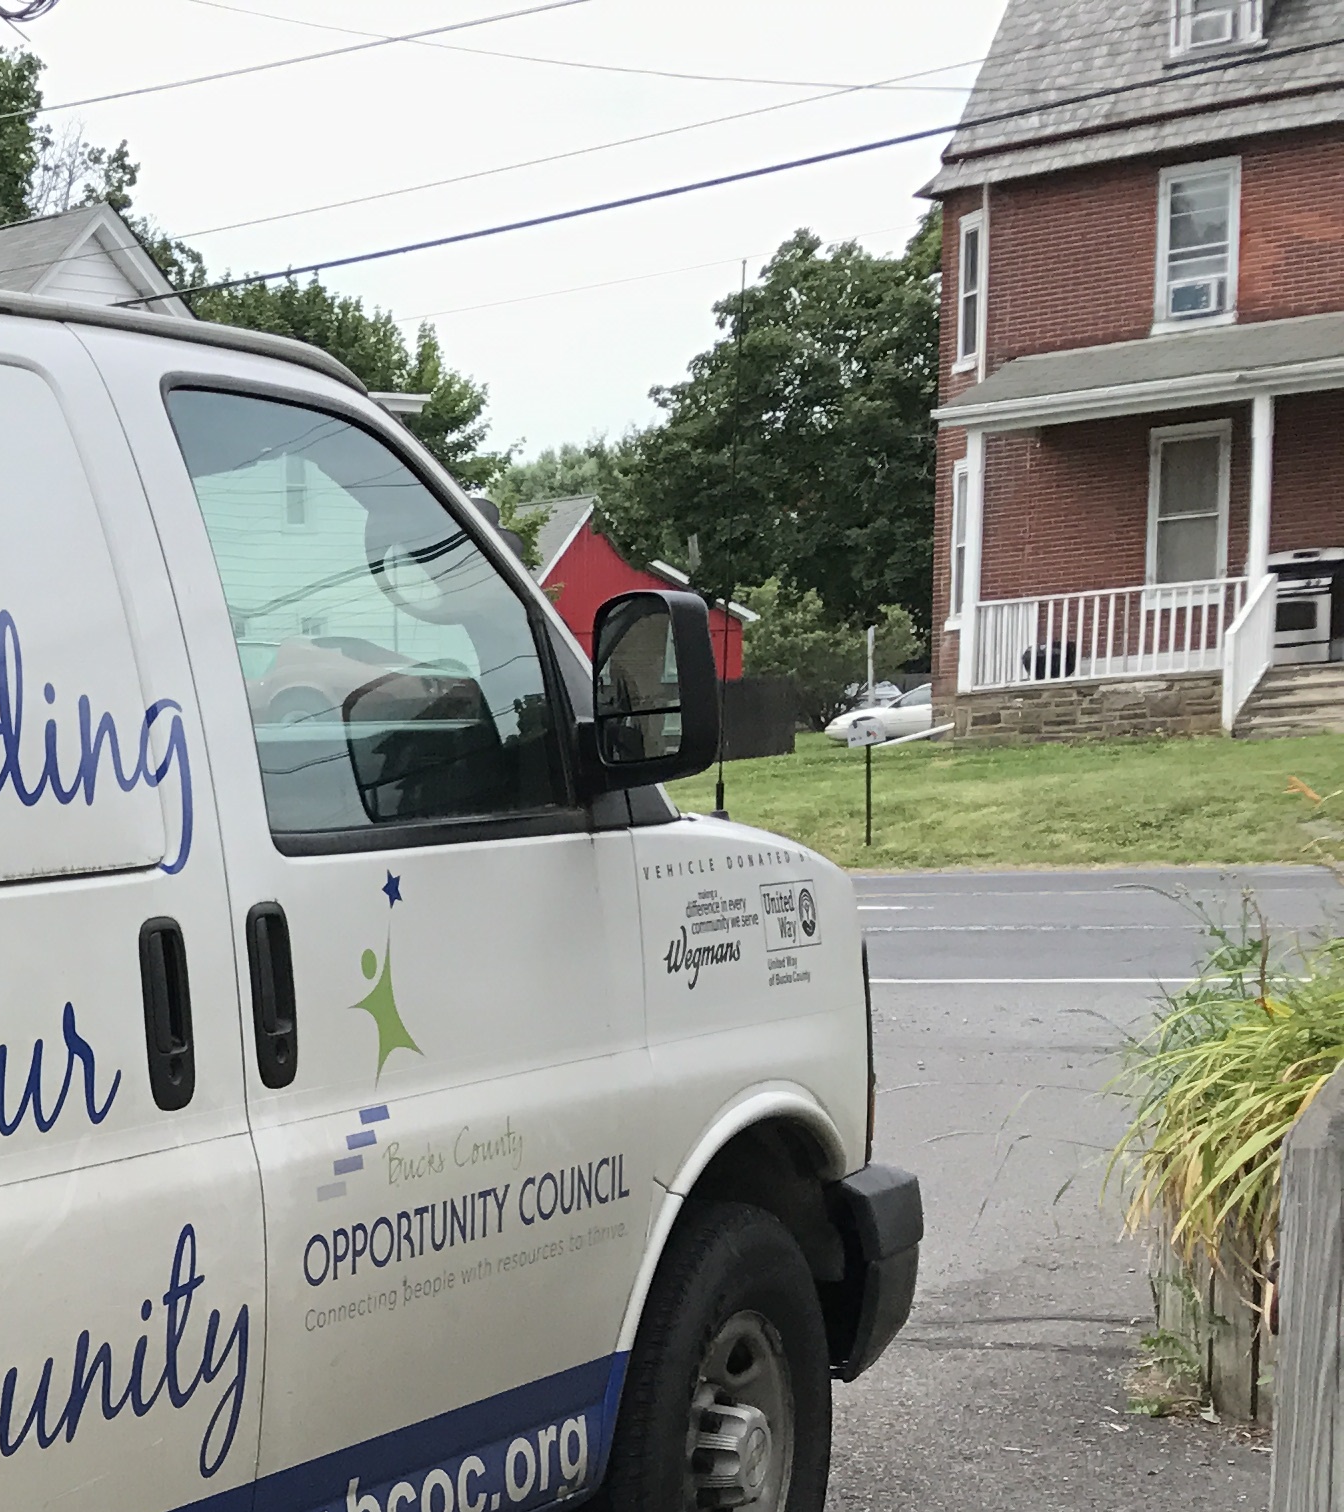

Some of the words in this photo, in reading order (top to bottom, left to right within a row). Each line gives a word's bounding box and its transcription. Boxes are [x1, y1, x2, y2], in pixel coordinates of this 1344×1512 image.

[643, 858, 714, 880] VEHICLE
[727, 851, 790, 870] DONATED
[686, 899, 720, 918] difference
[720, 897, 728, 912] in
[728, 897, 747, 914] every
[763, 889, 795, 915] United
[741, 912, 759, 928] serve
[777, 915, 797, 943] Way
[663, 925, 741, 990] Wegmans
[767, 957, 786, 971] United
[382, 1141, 445, 1185] Bucks
[453, 1116, 523, 1171] County
[303, 1183, 511, 1287] OPPORTUNITY
[518, 1153, 630, 1226] COUNCIL
[304, 1287, 397, 1333] Connecting
[402, 1270, 455, 1304] people
[461, 1258, 492, 1286] with
[496, 1239, 566, 1272] resources
[569, 1230, 583, 1252] to
